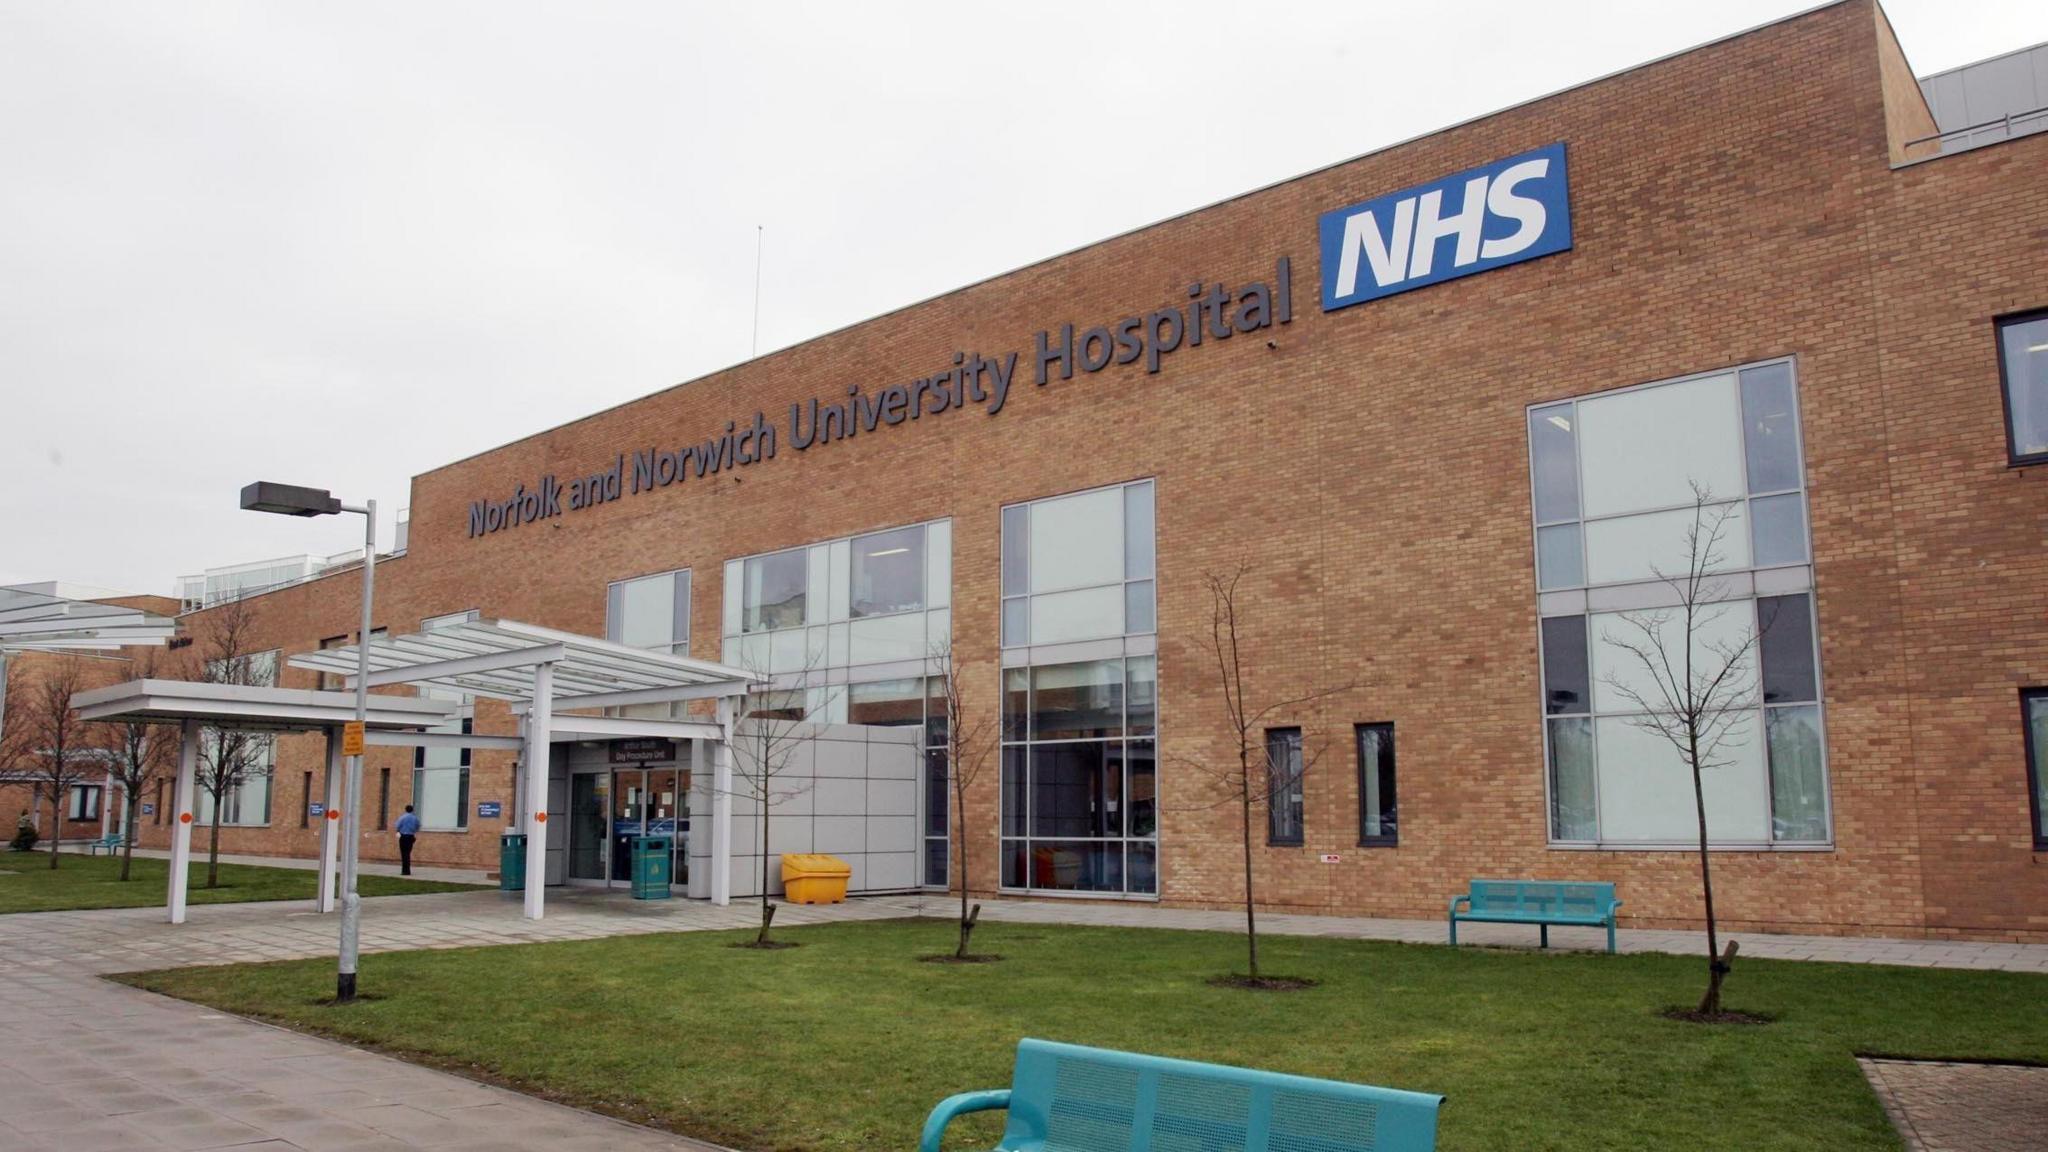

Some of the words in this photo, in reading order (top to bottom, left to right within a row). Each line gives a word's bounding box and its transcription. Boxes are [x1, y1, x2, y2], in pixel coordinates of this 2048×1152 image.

[1335, 158, 1549, 299] NHS
[467, 474, 563, 538] Norfolk
[569, 453, 624, 511] and
[630, 411, 776, 494] Norwich
[788, 352, 1018, 451] University
[1034, 255, 1292, 386] Hospital
